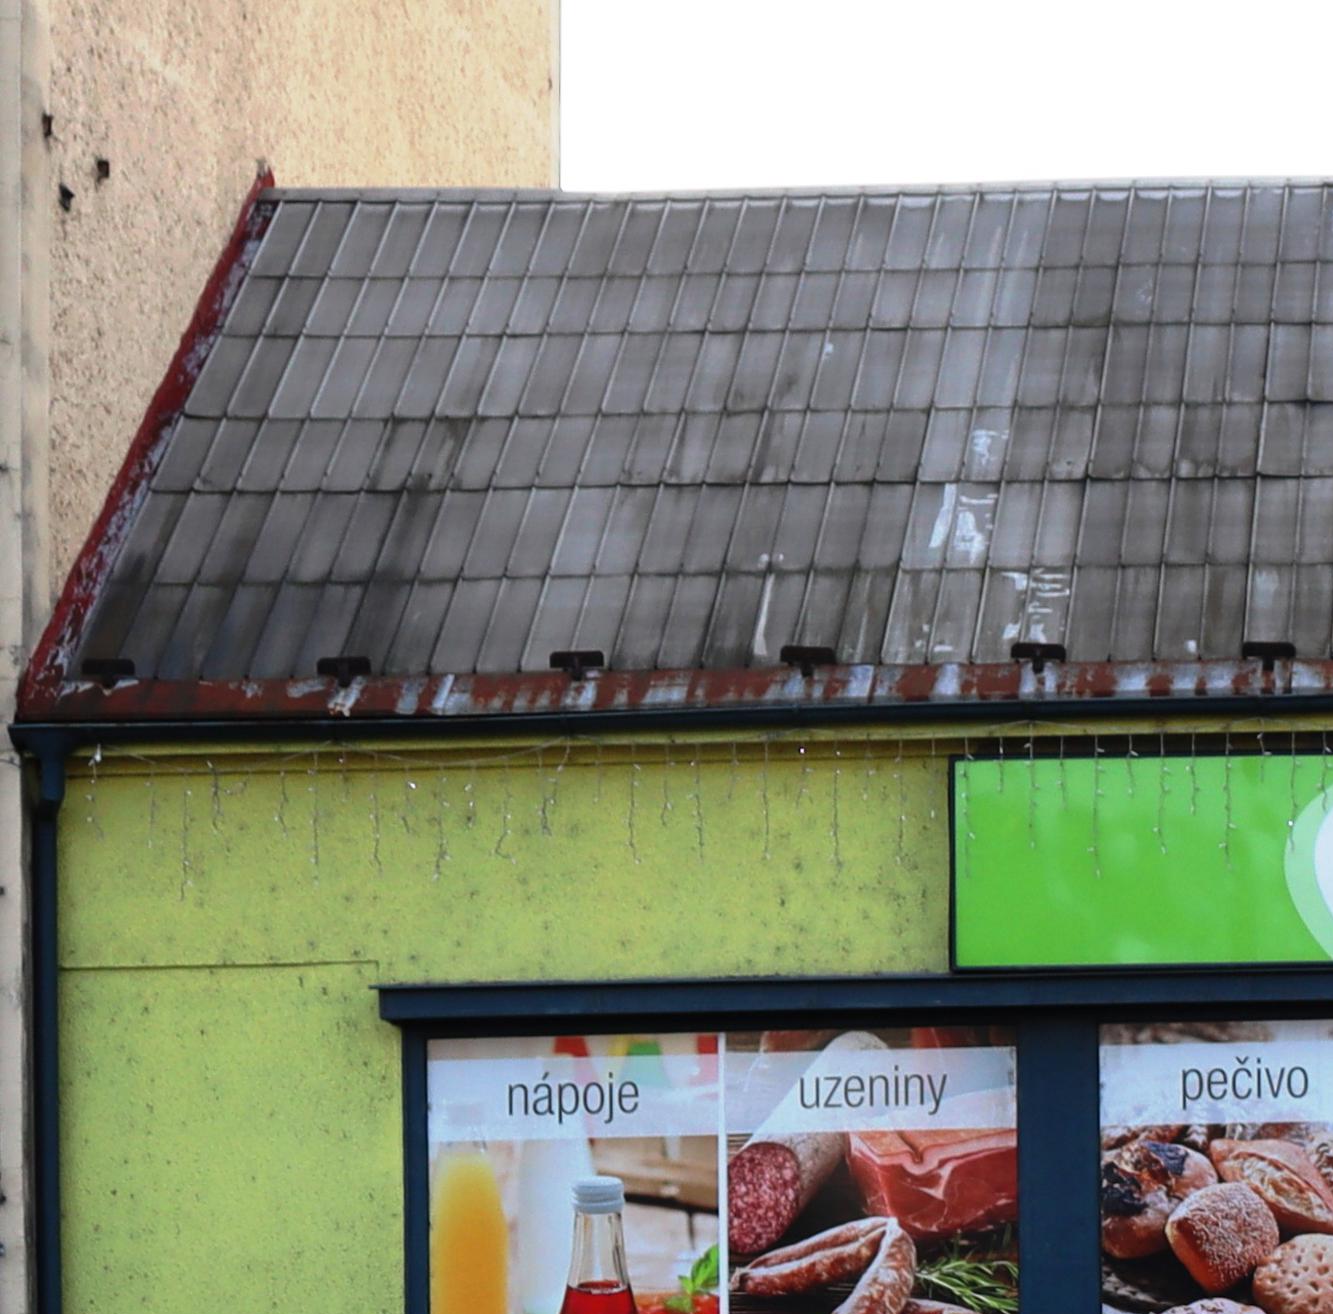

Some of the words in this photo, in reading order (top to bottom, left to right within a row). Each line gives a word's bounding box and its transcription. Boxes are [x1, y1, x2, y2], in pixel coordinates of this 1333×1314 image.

[507, 1071, 640, 1124] nápoje
[799, 1064, 948, 1115] uzeniny
[1181, 1056, 1309, 1110] pečivo
